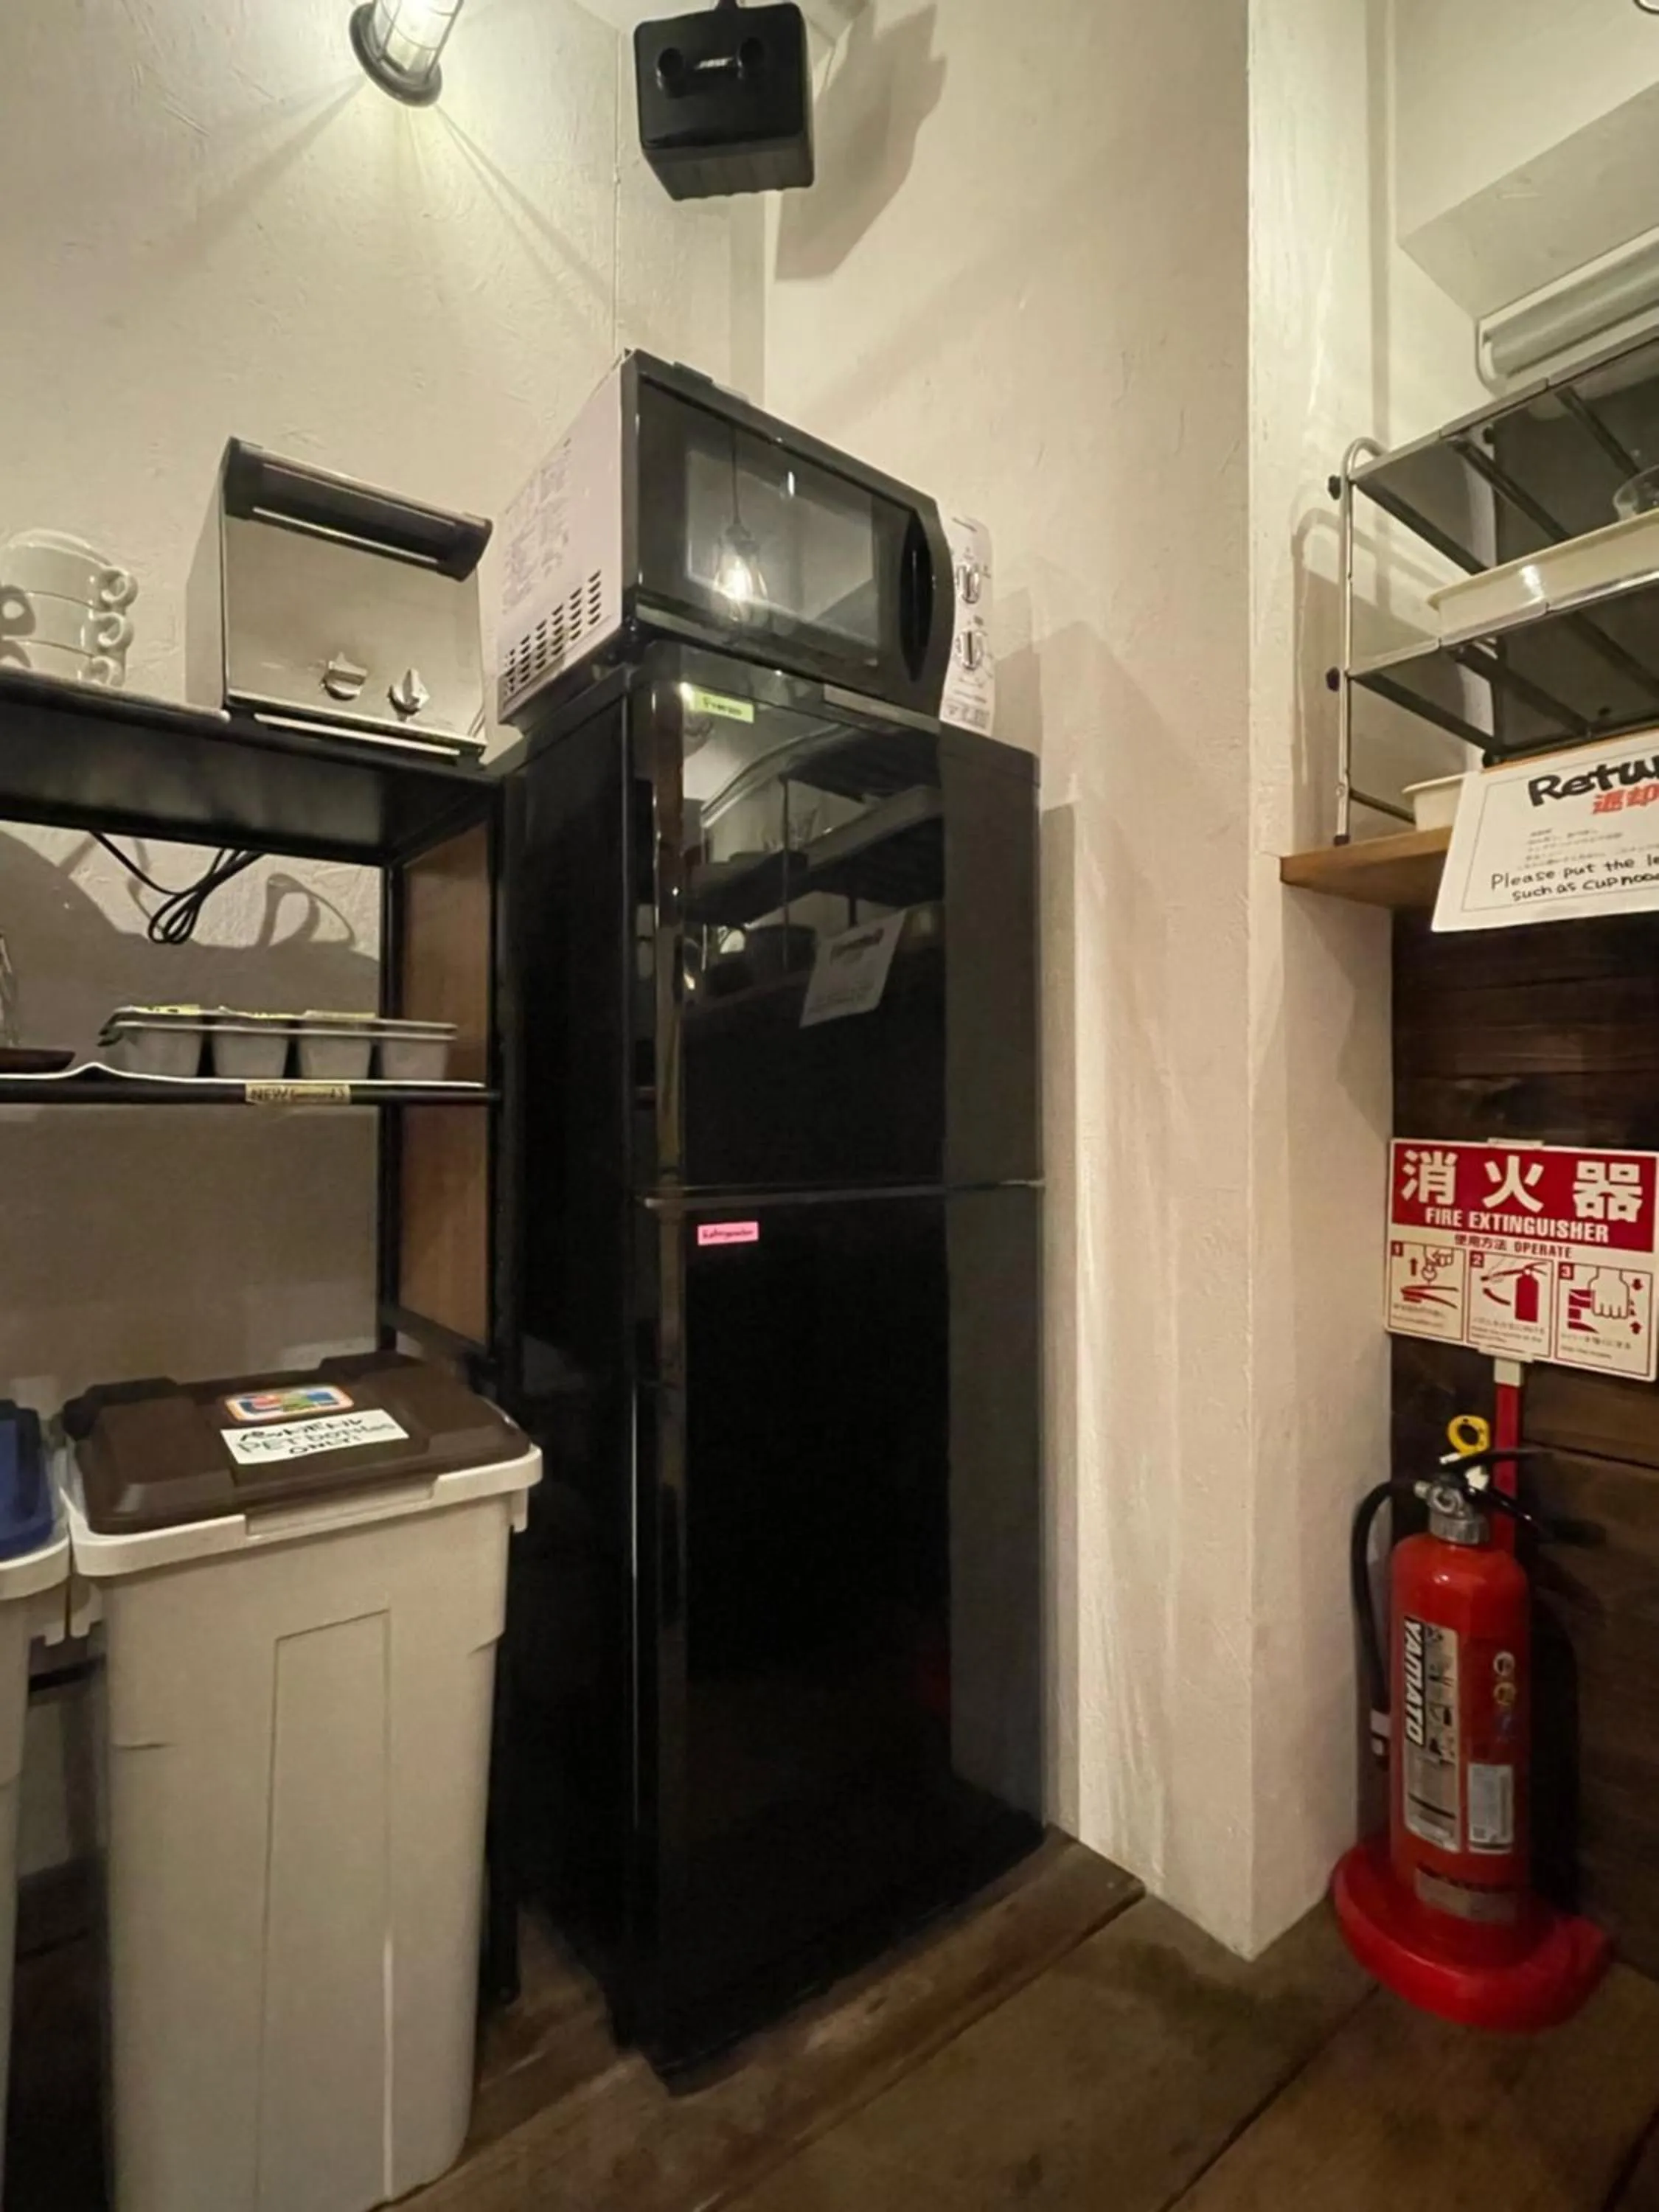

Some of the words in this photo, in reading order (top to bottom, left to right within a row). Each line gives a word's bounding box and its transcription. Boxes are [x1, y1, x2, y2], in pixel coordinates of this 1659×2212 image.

[1491, 870, 1555, 891] Please
[1563, 863, 1595, 879] put
[1604, 858, 1635, 872] the
[1425, 1207, 1462, 1227] FIRE
[1469, 1212, 1609, 1242] EXTINGUISHER
[1514, 1240, 1572, 1259] OPERATE
[1405, 1620, 1424, 1745] YAMATO
